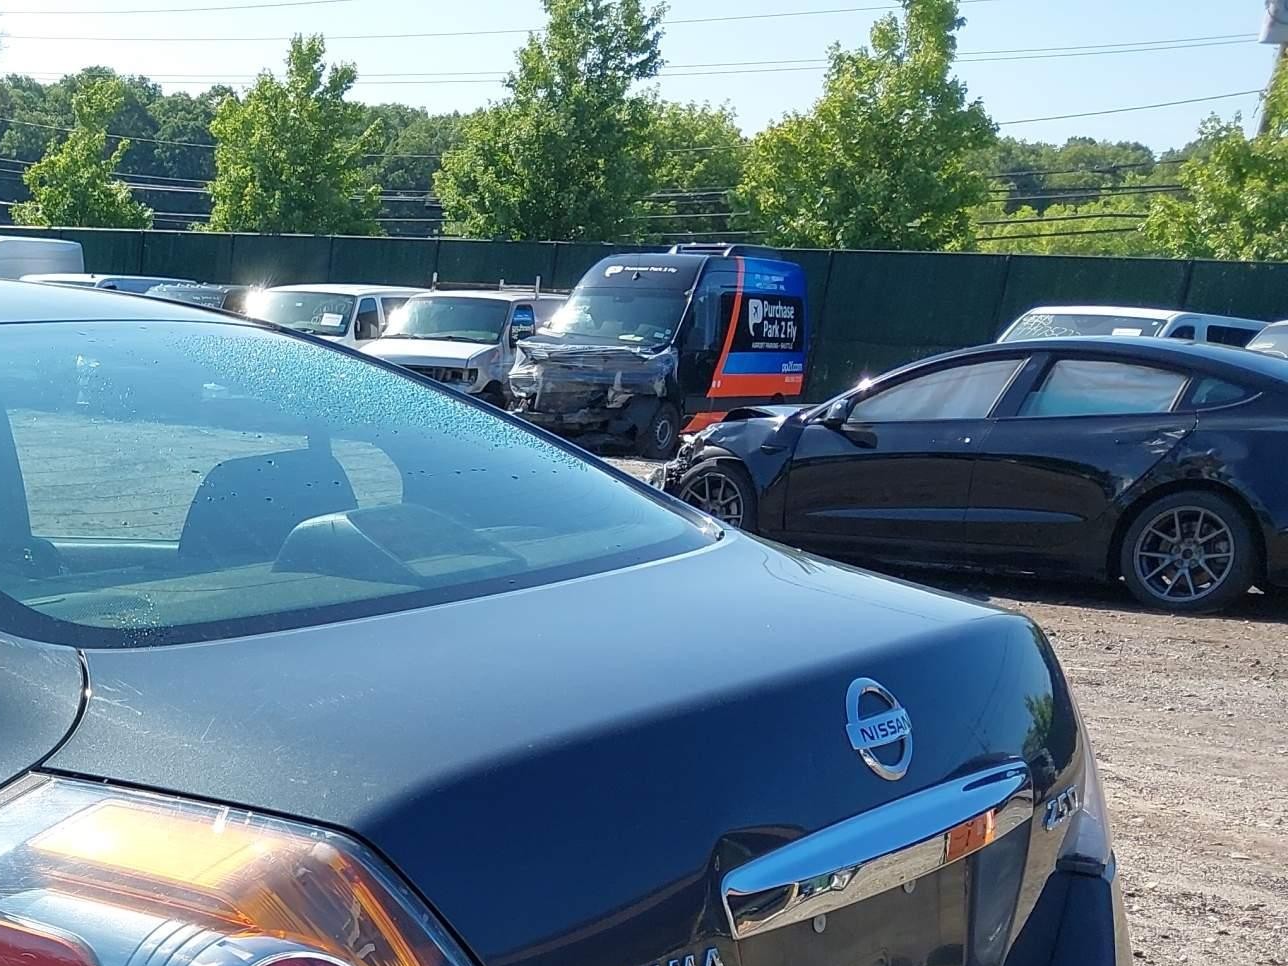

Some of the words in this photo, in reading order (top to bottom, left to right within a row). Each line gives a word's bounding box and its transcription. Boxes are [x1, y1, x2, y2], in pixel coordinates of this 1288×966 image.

[763, 300, 795, 319] Purchase
[762, 320, 780, 338] Park
[780, 321, 786, 338] 2
[787, 321, 797, 342] Fly
[860, 715, 912, 743] NISSAN
